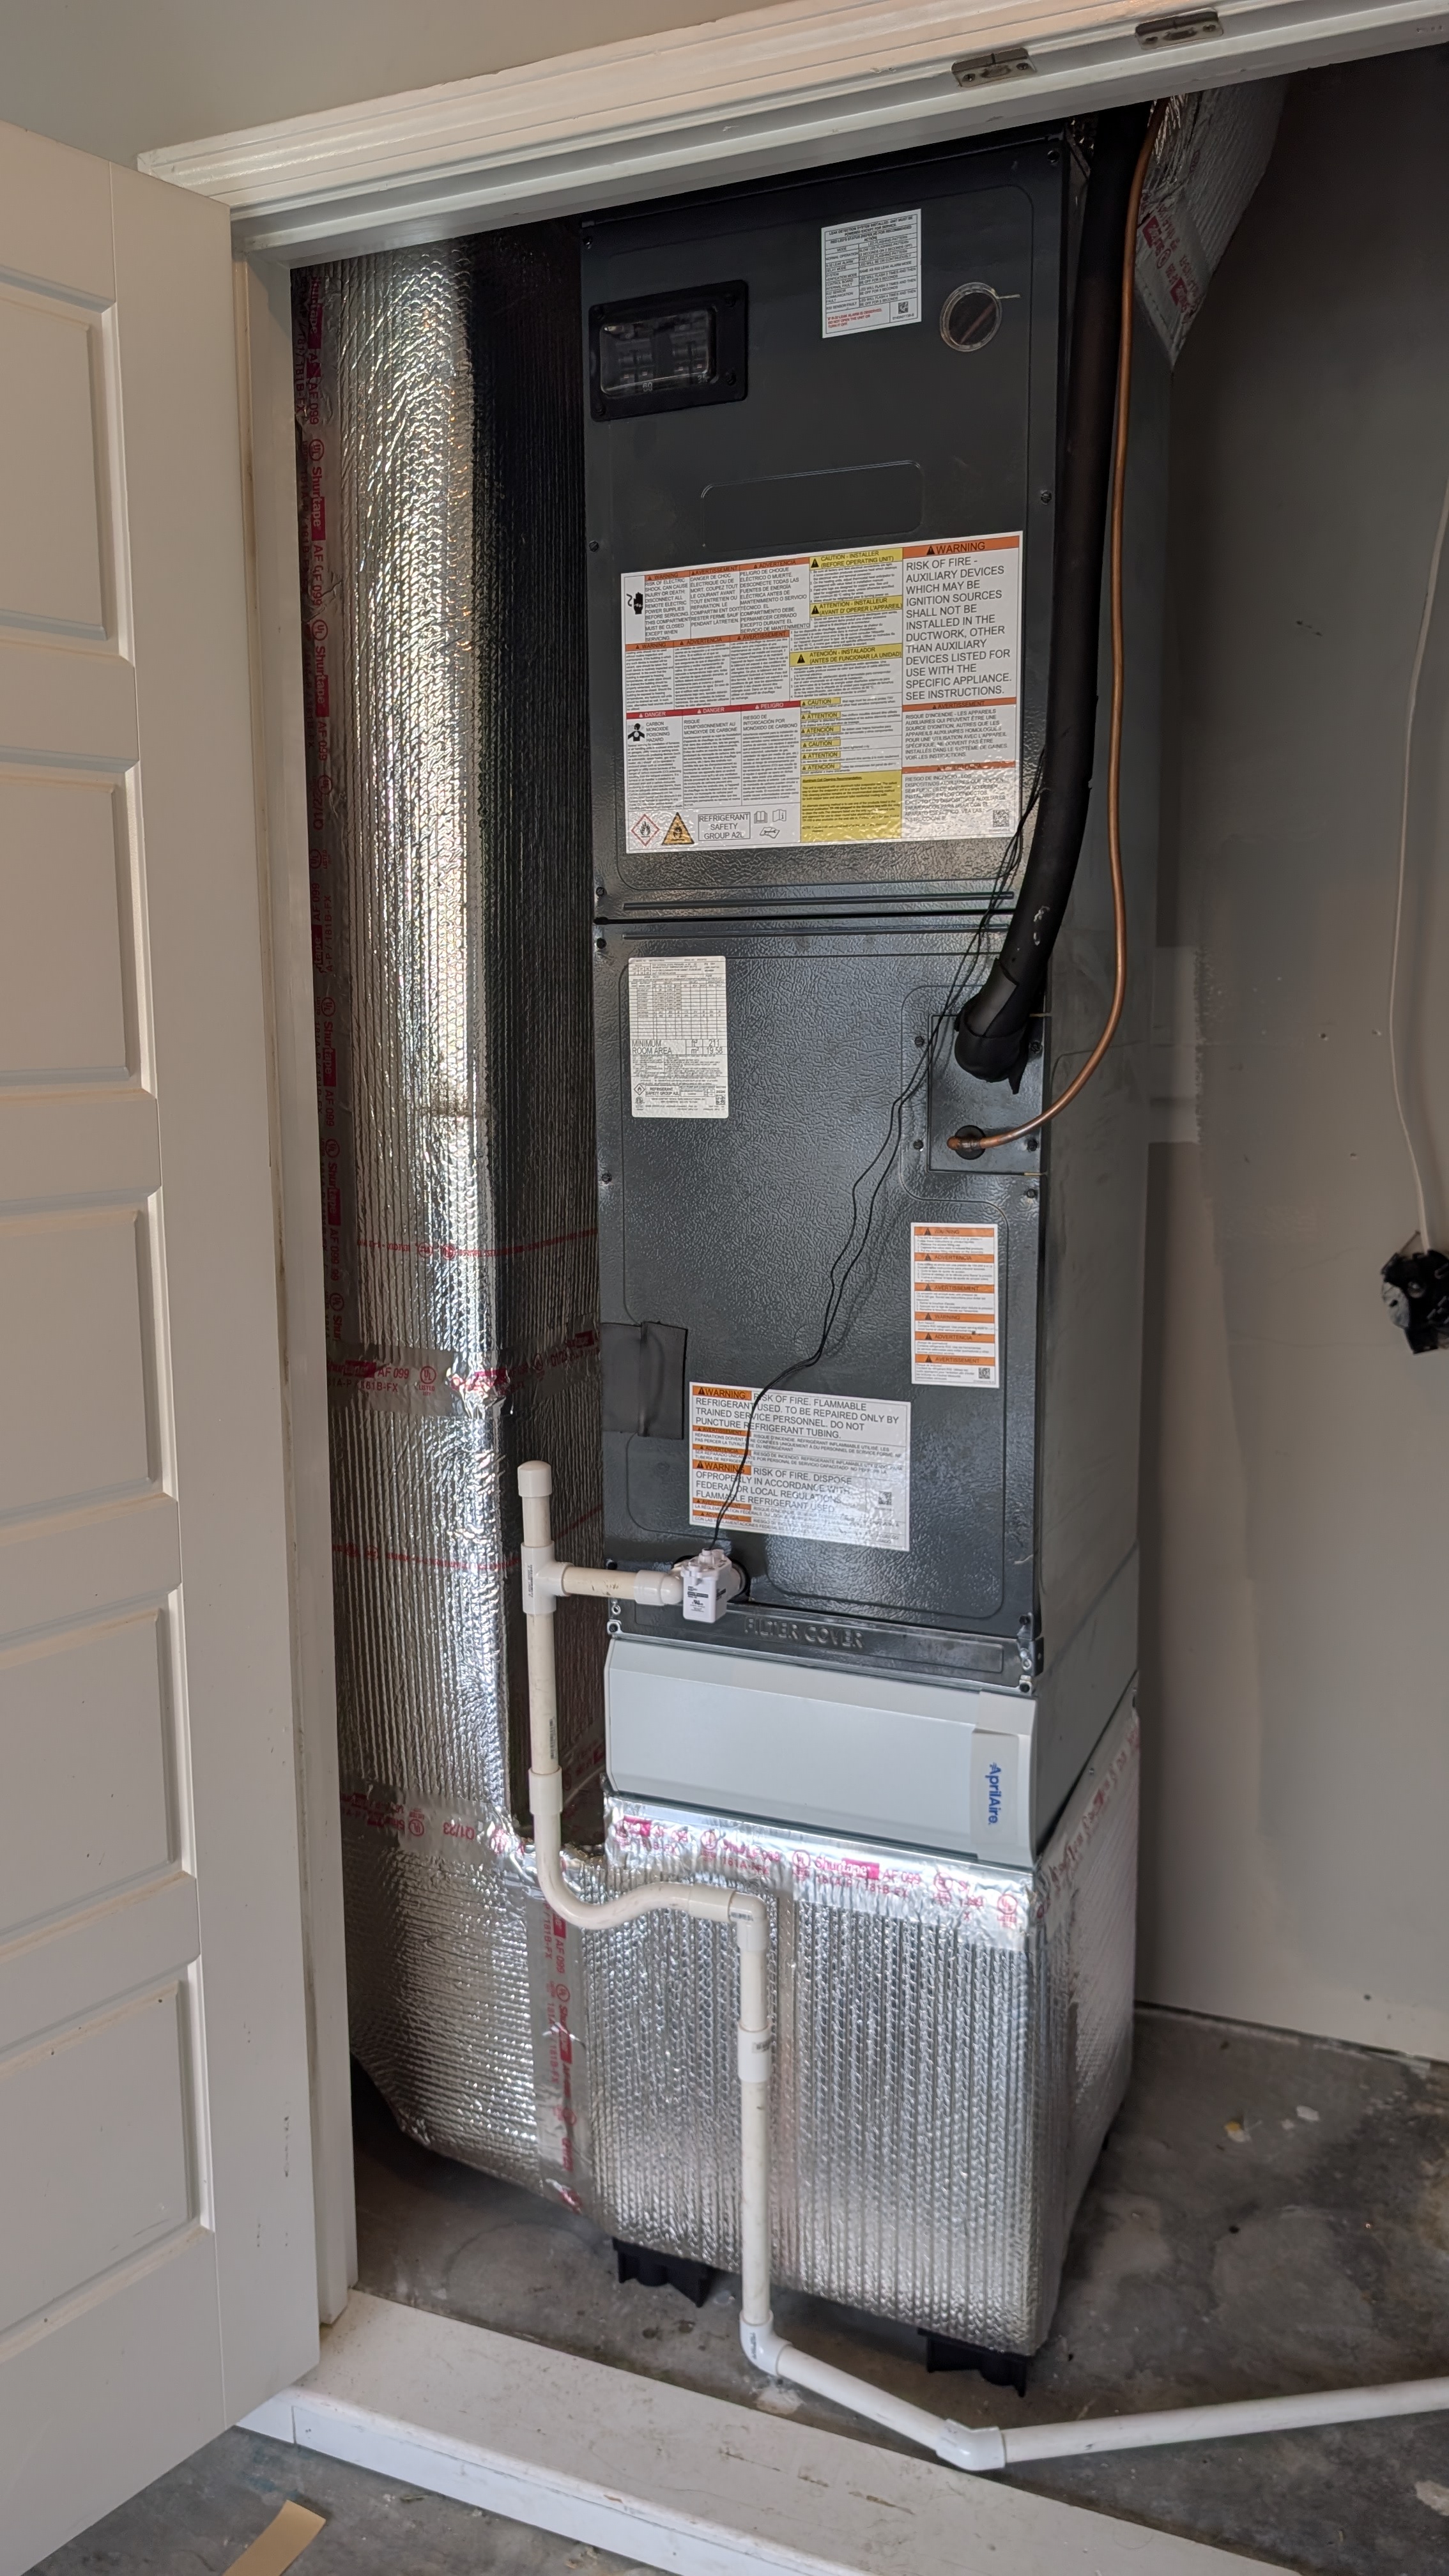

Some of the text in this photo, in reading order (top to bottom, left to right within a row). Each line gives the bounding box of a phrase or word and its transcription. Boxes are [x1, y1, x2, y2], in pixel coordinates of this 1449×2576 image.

[849, 550, 879, 558] INSTALLER
[936, 540, 986, 555] WARNING
[694, 565, 737, 575] AVERTISSEMENT
[758, 559, 796, 568] ADVERTENCIA
[821, 560, 845, 569] (BEFORE
[845, 556, 878, 566] OPERATING
[906, 560, 929, 572] RISK
[931, 558, 946, 569] OF
[948, 556, 971, 567] FIRE
[905, 564, 1004, 583] AUXILIARY DEVICES
[905, 579, 980, 595] WHICH MAY BE
[854, 597, 887, 606] INSTALLEUR
[906, 589, 1002, 607] IGNITION SOURCES
[870, 602, 902, 611] L'APPAREIL)
[906, 603, 977, 619] SHALL NOT BE
[906, 613, 995, 631] INSTALLED IN THE
[686, 636, 722, 645] ADVERTENCIA
[742, 631, 786, 640] AVERTISSEMENT
[906, 625, 1005, 643] DUCTWORK, OTHER
[841, 646, 875, 655] INSTALADOR
[905, 638, 986, 654] THAN AUXILIARY
[838, 654, 870, 662] FUNCIONAR
[906, 648, 1010, 666] DEVICES LISTED FOR
[906, 663, 976, 678] USE WITH THE
[905, 672, 1011, 689] SPECIFIC APPLIANCE.
[905, 690, 925, 702] SEE
[928, 684, 1004, 700] INSTRUCTIONS.
[937, 700, 985, 709] AVERTISSEMENT
[698, 813, 749, 822] REFRIGERANT
[710, 822, 738, 831] SAFETY
[703, 831, 730, 840] GROUP
[378, 1367, 410, 1379] AF 099
[705, 1388, 746, 1399] WARNING
[753, 1392, 866, 1411] RSK OF FIRE. FLAMMABLE
[695, 1407, 732, 1418] TRAINED
[772, 1414, 827, 1427] PERSONNEL.
[830, 1420, 843, 1429] DO
[845, 1422, 865, 1431] NOT
[757, 1402, 782, 1413] USED.
[785, 1405, 797, 1414] TO
[799, 1407, 811, 1416] BE
[813, 1408, 858, 1420] REPAIRED
[860, 1413, 885, 1423] ONLY
[887, 1415, 900, 1424] BY
[695, 1416, 740, 1429] PUNCTURE
[806, 1427, 841, 1439] TUBING.
[753, 1467, 852, 1485] RISK OF FIRE. DISPOSE
[750, 1486, 778, 1496] LOCAL
[754, 1476, 762, 1485] IN
[764, 1478, 825, 1492] ACCORDANCE
[747, 1496, 808, 1510] REFRIGERANT
[804, 1624, 864, 1648] COVER
[985, 1762, 1001, 1823] AprilAire
